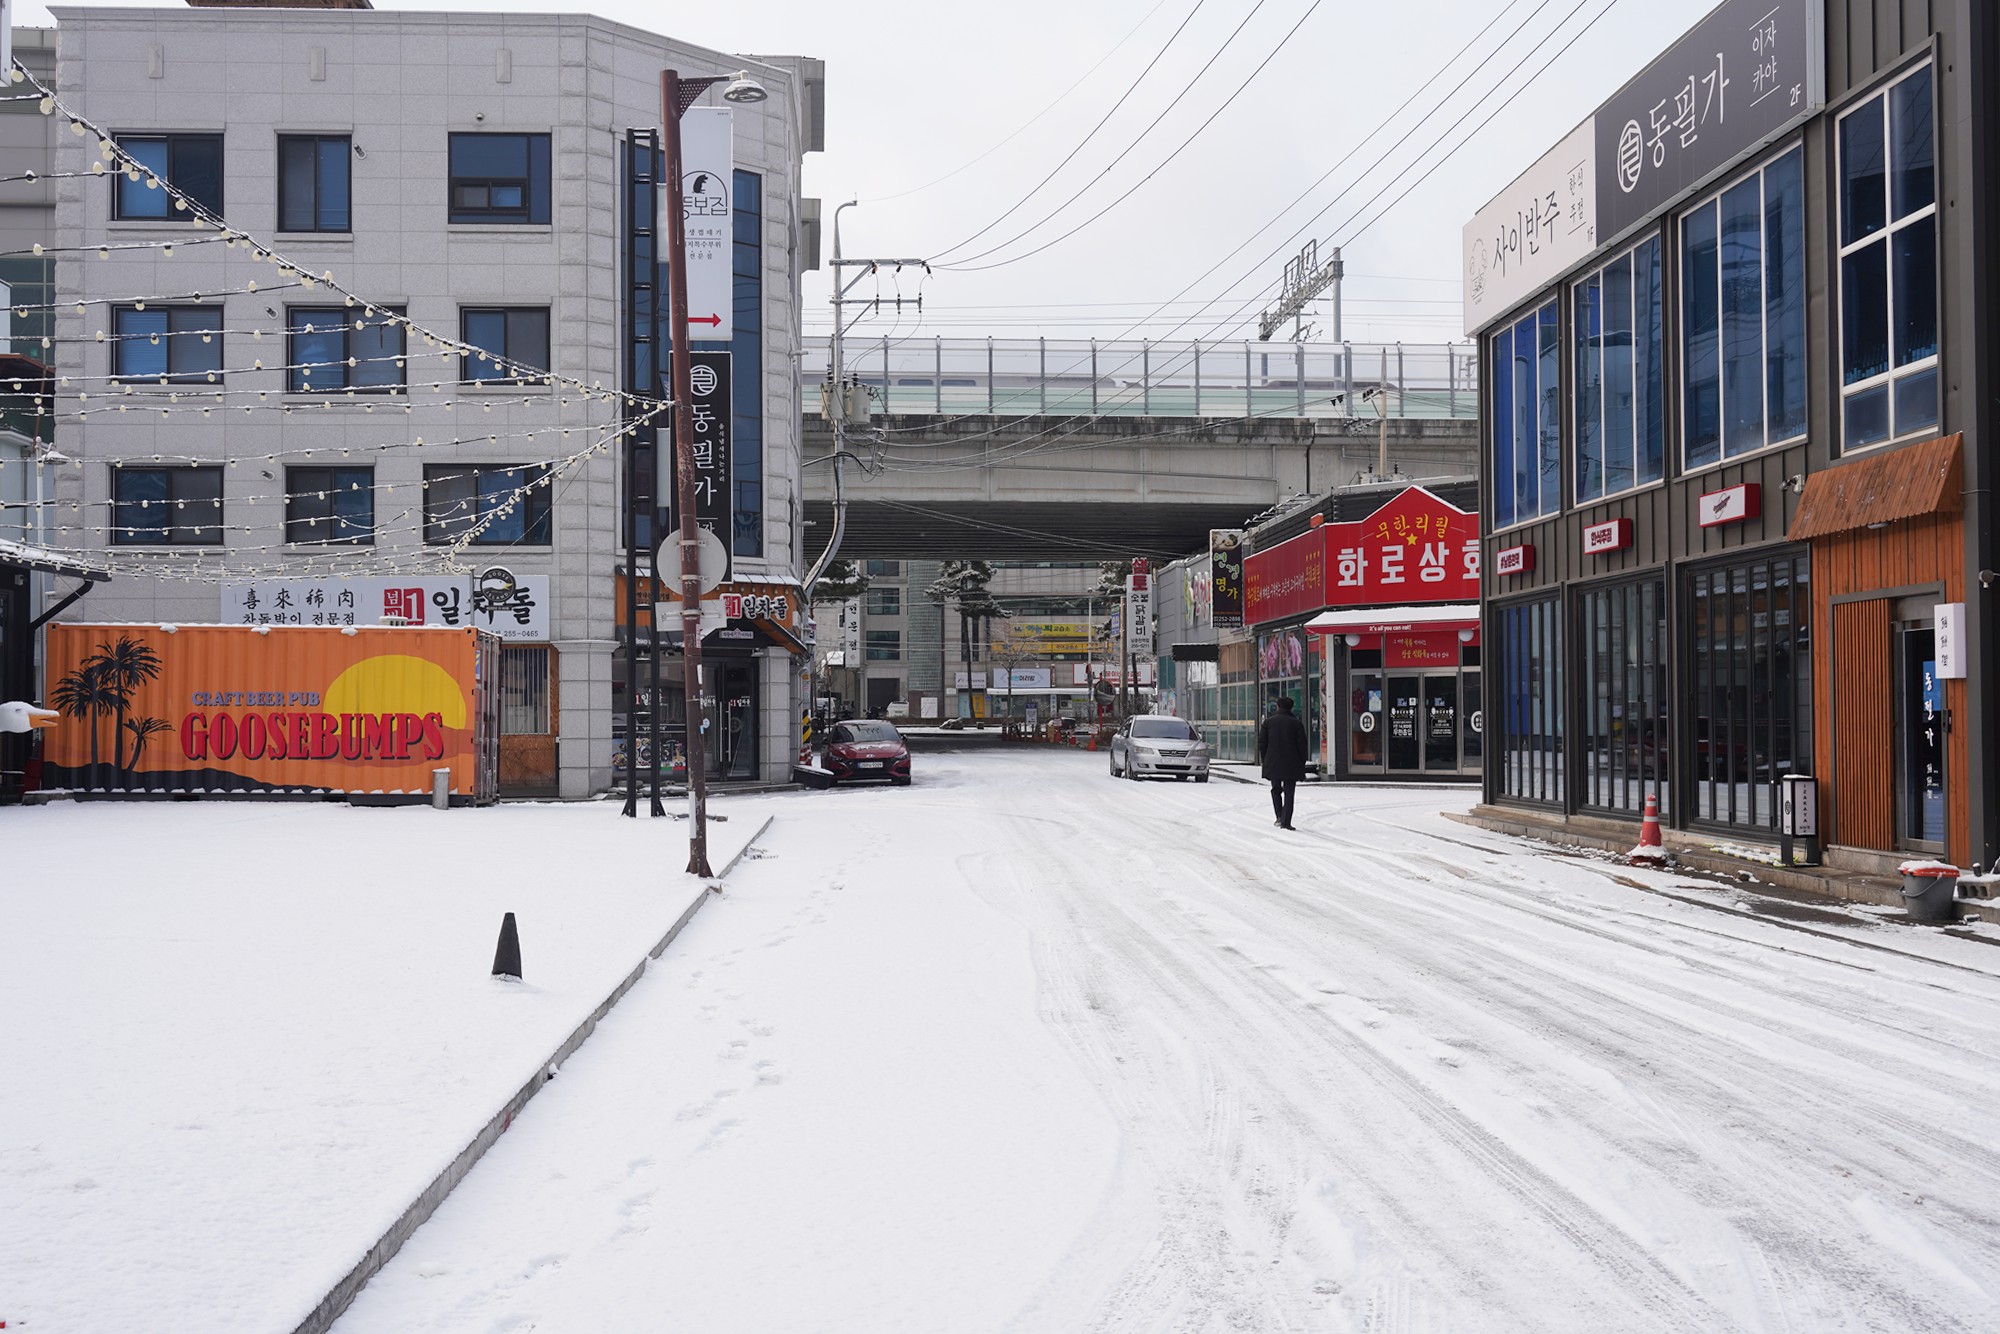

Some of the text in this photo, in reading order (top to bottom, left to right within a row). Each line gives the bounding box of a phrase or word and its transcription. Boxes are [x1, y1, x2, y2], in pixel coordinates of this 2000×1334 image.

[1752, 19, 1777, 57] 이자
[1752, 55, 1777, 94] 카야
[1789, 83, 1802, 107] 2F
[1646, 52, 1730, 168] 동필가
[1569, 167, 1584, 196] 한식
[1569, 197, 1584, 225] 주점
[1492, 190, 1561, 279] 사이반주
[691, 403, 718, 507] 동필가
[1375, 512, 1449, 542] 무한리필
[1591, 528, 1613, 547] 한식주점
[487, 571, 509, 580] GOOSE
[1215, 577, 1239, 600] 명가
[242, 611, 355, 626] 차돌박이 전문점
[743, 595, 788, 619] 일차돌
[1135, 604, 1147, 636] 닭갈비
[191, 691, 321, 707] CRAFT BEER PUB
[180, 711, 445, 761] GOOSEBUMPS
